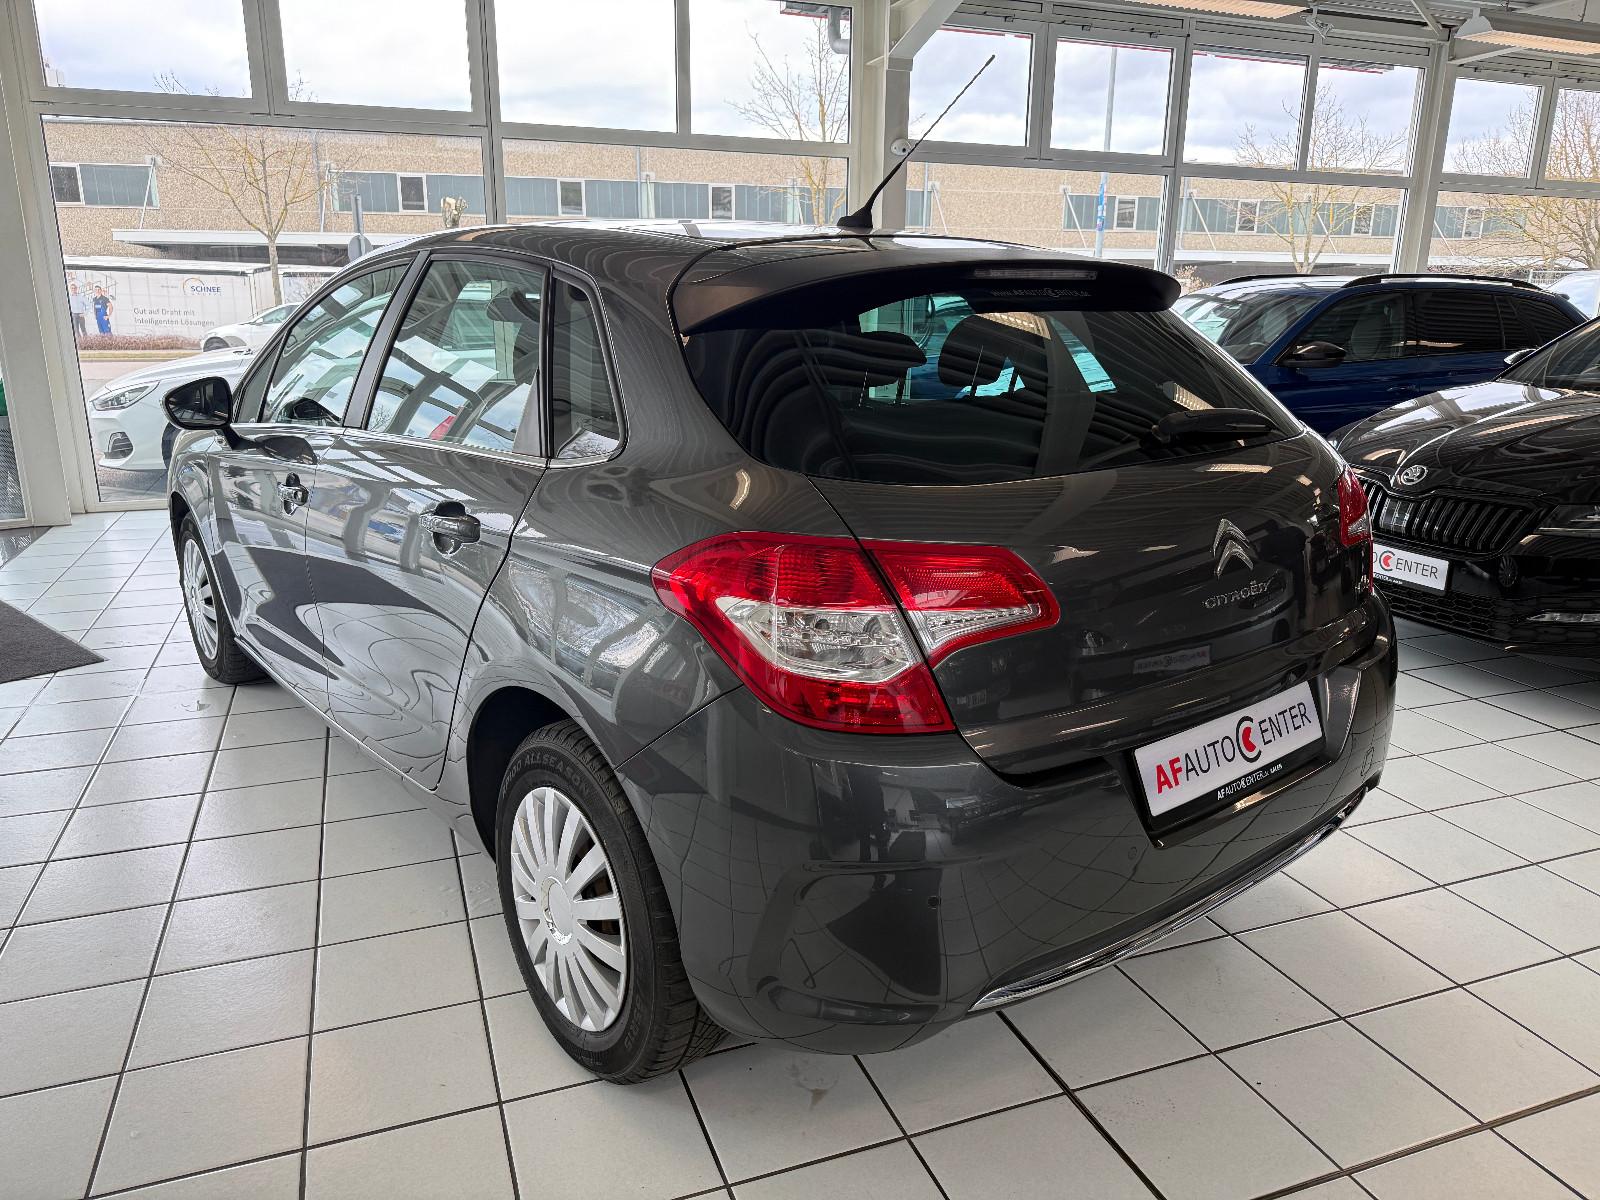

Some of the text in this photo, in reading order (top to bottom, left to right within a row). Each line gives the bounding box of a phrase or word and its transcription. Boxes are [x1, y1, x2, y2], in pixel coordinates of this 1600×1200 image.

[190, 285, 221, 293] SCHNEE
[133, 307, 147, 315] Gut
[161, 308, 182, 317] Draht
[183, 309, 195, 317] mit
[180, 318, 215, 328] Lösungen
